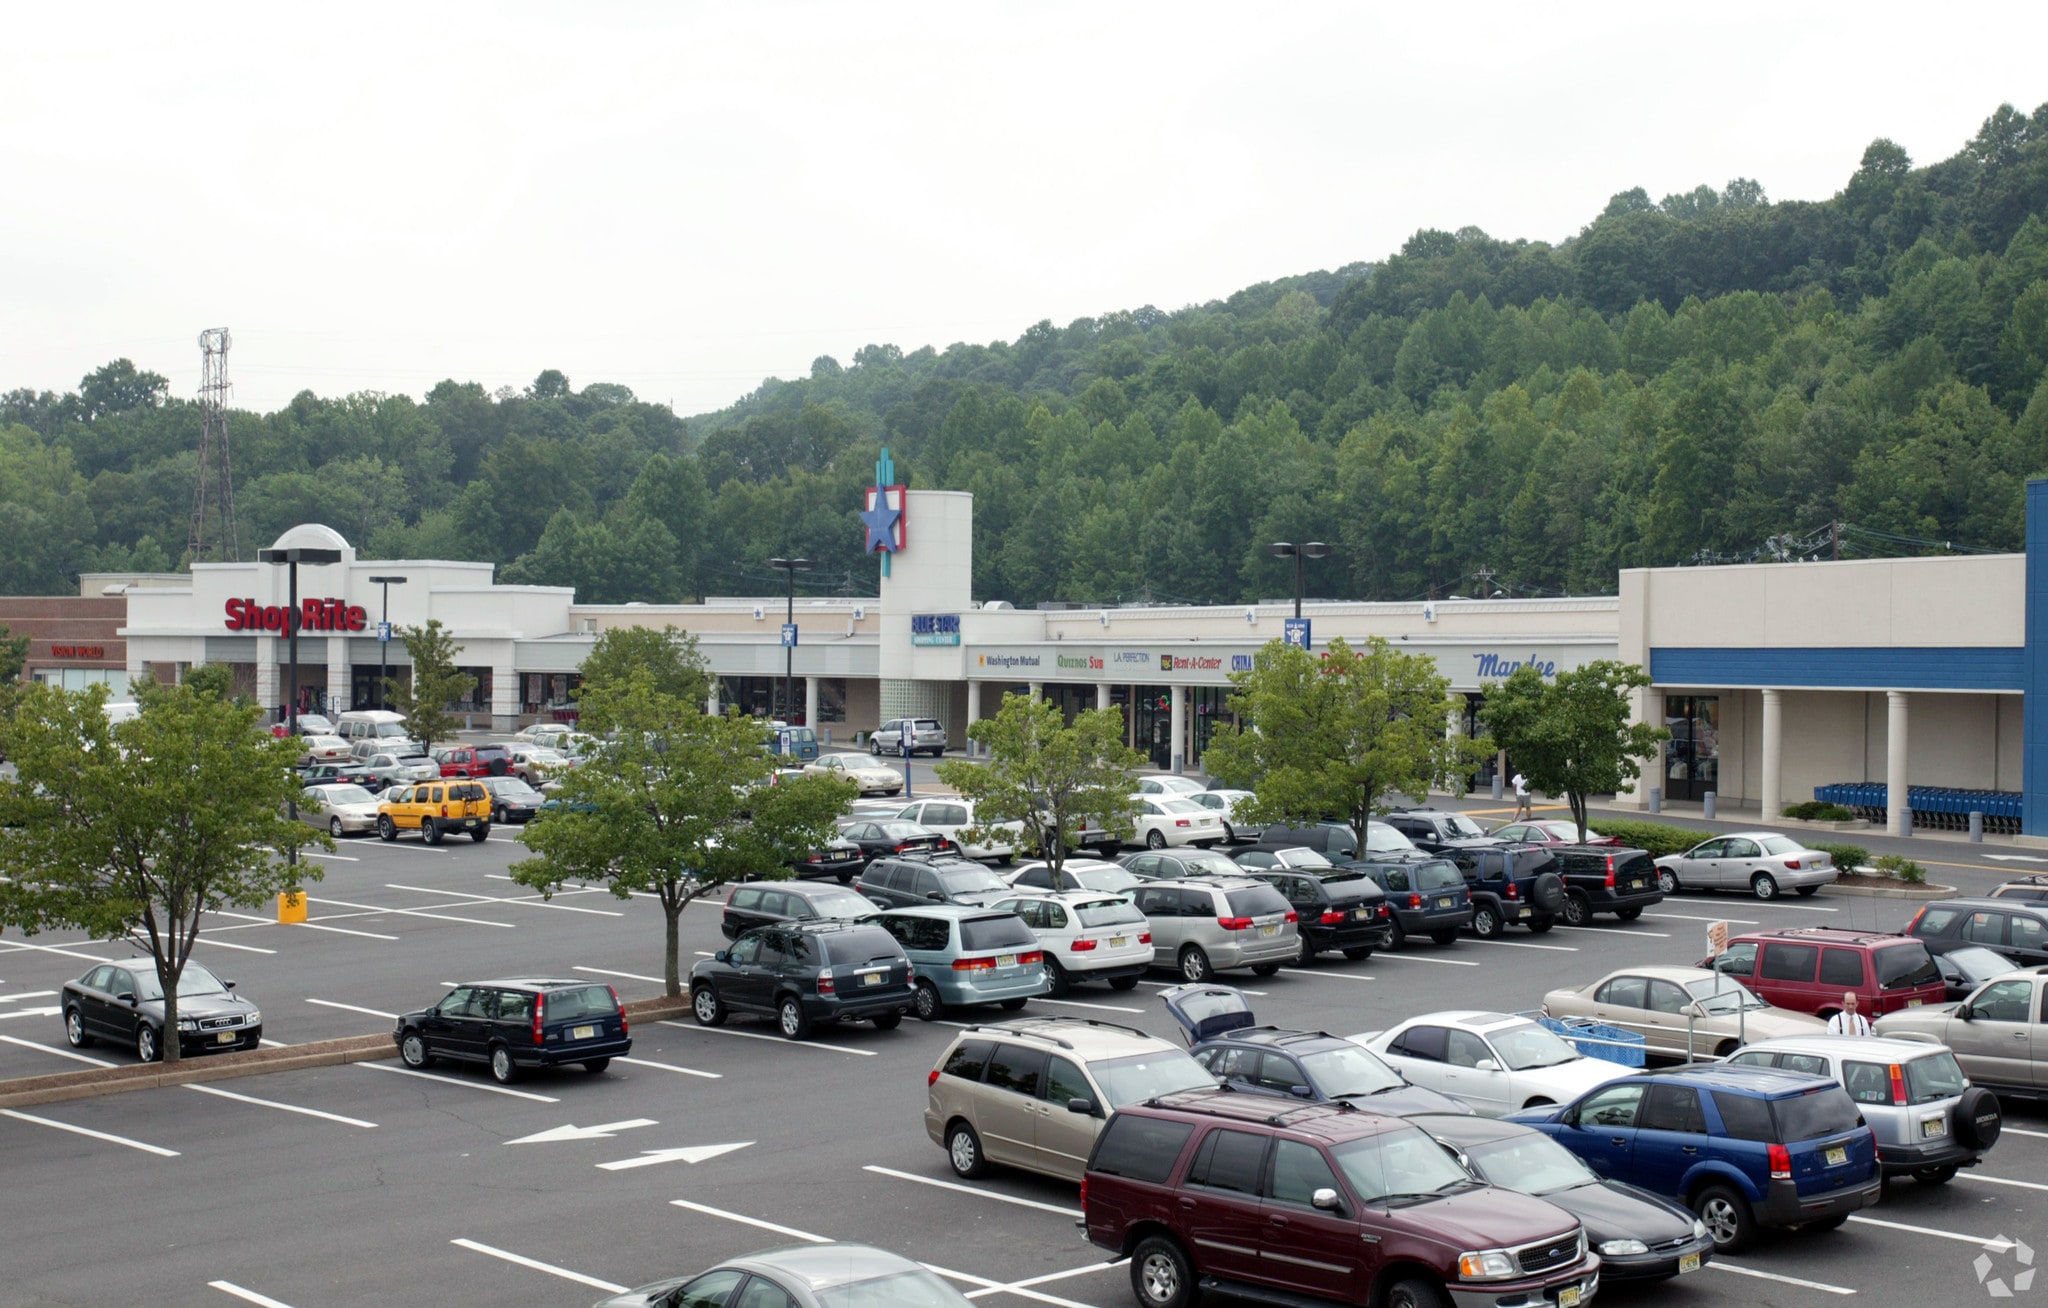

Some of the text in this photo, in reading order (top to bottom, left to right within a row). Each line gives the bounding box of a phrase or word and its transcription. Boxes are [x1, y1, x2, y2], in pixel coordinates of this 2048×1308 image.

[225, 597, 367, 640] ShopRite
[911, 614, 935, 633] BLUE
[51, 645, 103, 657] VISION WORLD
[986, 654, 1040, 669] Washington Mutual
[1231, 655, 1252, 671] CHINA
